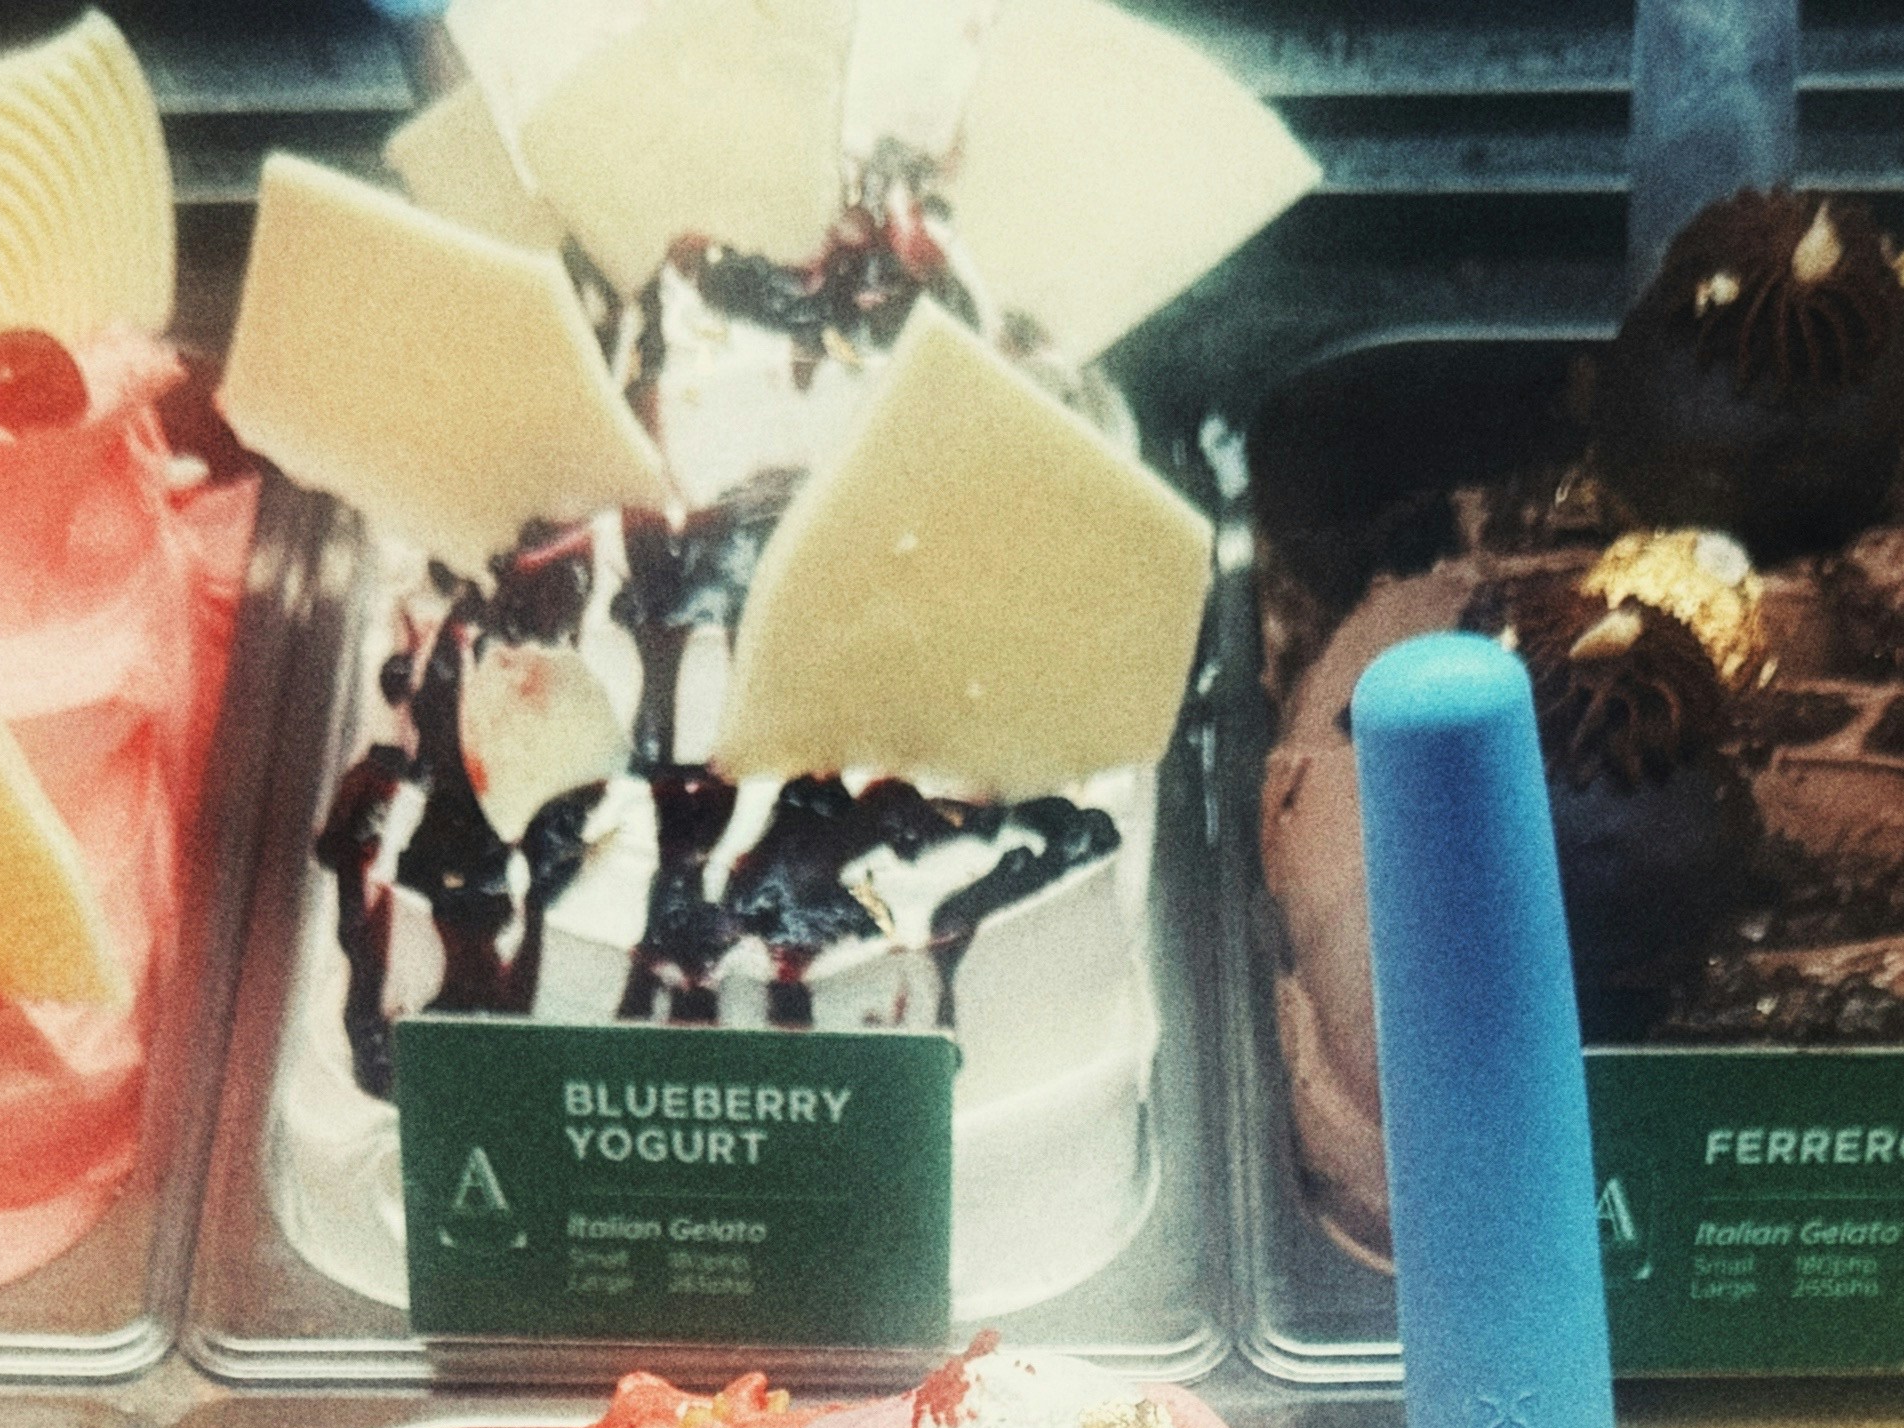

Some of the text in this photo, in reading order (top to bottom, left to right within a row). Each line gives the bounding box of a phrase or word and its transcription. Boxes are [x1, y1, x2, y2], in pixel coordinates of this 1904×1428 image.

[563, 1080, 853, 1124] BLUEBERRY
[563, 1125, 768, 1165] YOGURT
[566, 1215, 768, 1244] Italian Gelato
[1694, 1218, 1903, 1247] Italian Gelato
